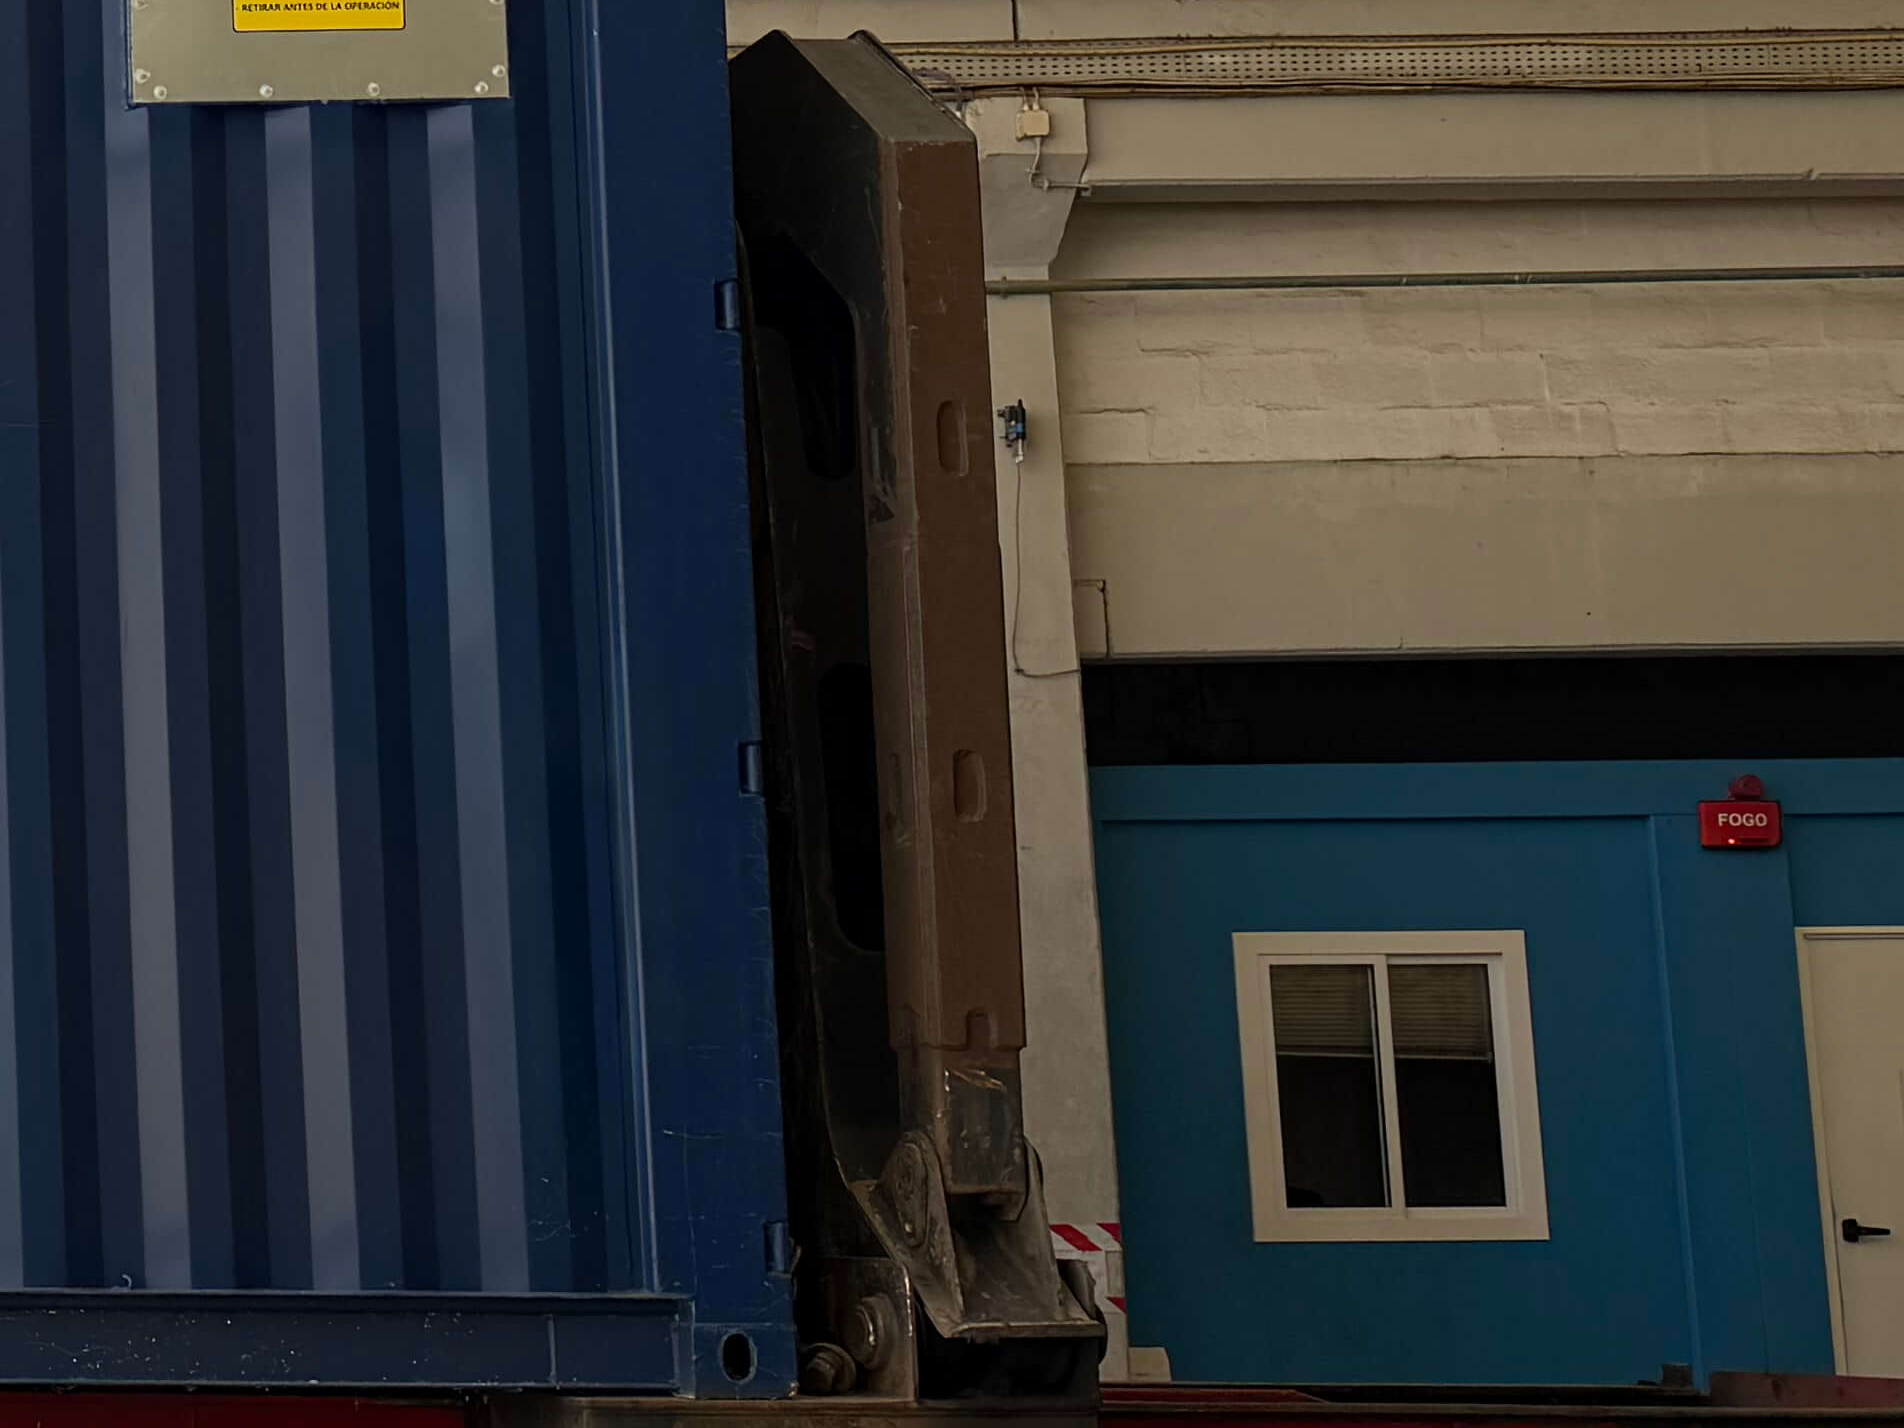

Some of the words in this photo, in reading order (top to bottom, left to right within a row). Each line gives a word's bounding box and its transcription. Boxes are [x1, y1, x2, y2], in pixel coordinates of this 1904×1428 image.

[241, 3, 281, 12] RETIRAR
[283, 3, 313, 11] ANTES
[316, 2, 328, 11] DE
[330, 2, 342, 11] LA
[1717, 813, 1768, 827] FOGO
